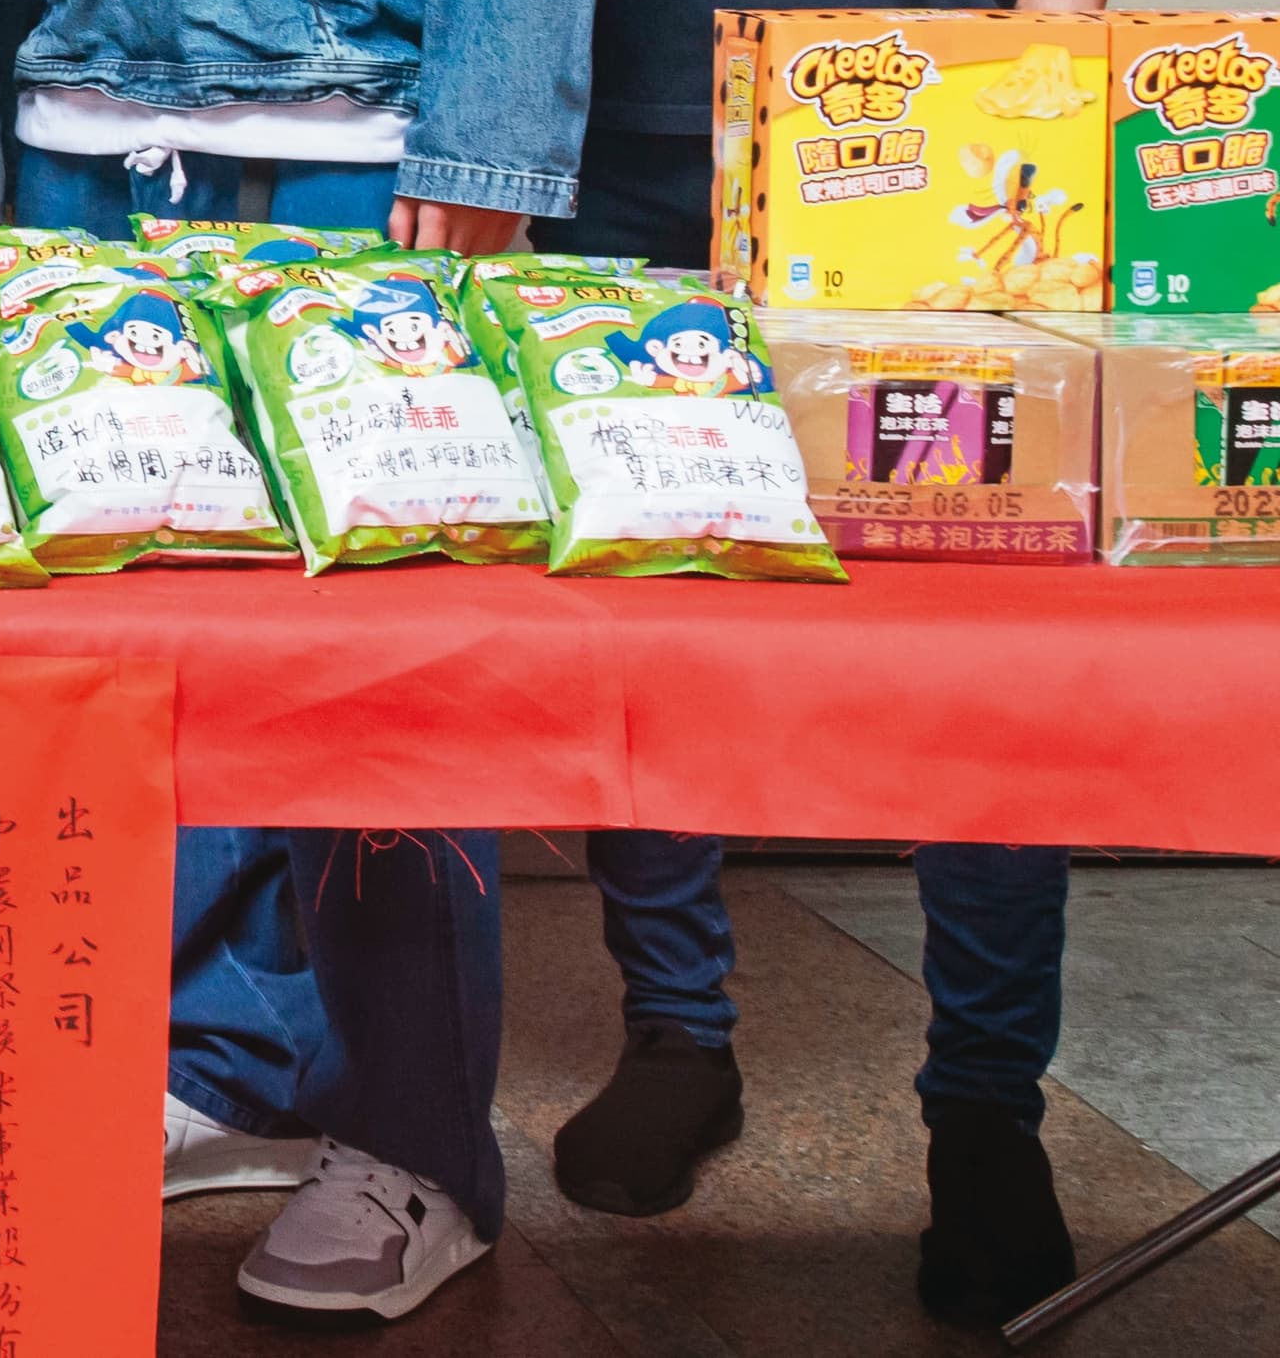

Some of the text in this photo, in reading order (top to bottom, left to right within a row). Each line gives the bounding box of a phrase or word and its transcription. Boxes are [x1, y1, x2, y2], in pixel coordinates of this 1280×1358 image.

[790, 34, 930, 99] Cheetos
[1131, 36, 1272, 103] Cheetos
[821, 81, 907, 126] 奇多
[1162, 83, 1249, 130] 奇多
[797, 129, 924, 175] 隨口脆
[1140, 131, 1268, 180] 隨口脆
[824, 270, 843, 285] 10
[1167, 273, 1190, 292] 10
[835, 487, 1024, 518] 2023.08.05
[863, 522, 1079, 553] 生活泡沫花茶
[51, 797, 97, 1047] 出品公司
